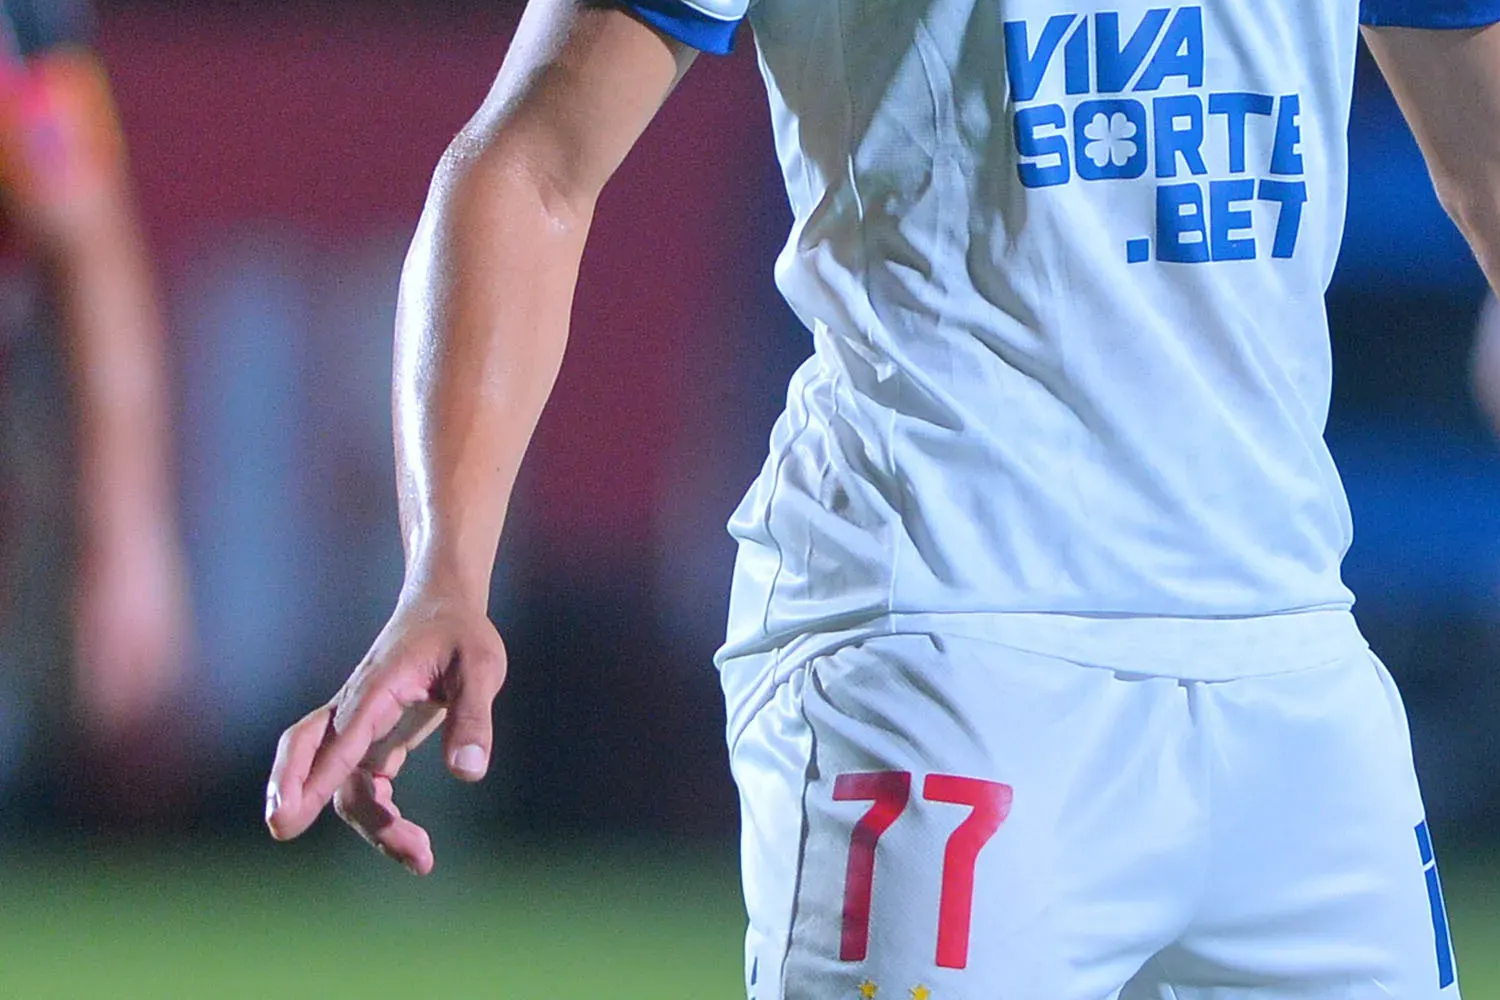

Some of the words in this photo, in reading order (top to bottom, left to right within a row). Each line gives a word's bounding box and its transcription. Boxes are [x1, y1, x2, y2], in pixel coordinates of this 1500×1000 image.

[1004, 5, 1204, 102] VIVA
[1014, 91, 1305, 189] SORTE
[1126, 178, 1308, 264] .BET
[831, 770, 1014, 970] 77
